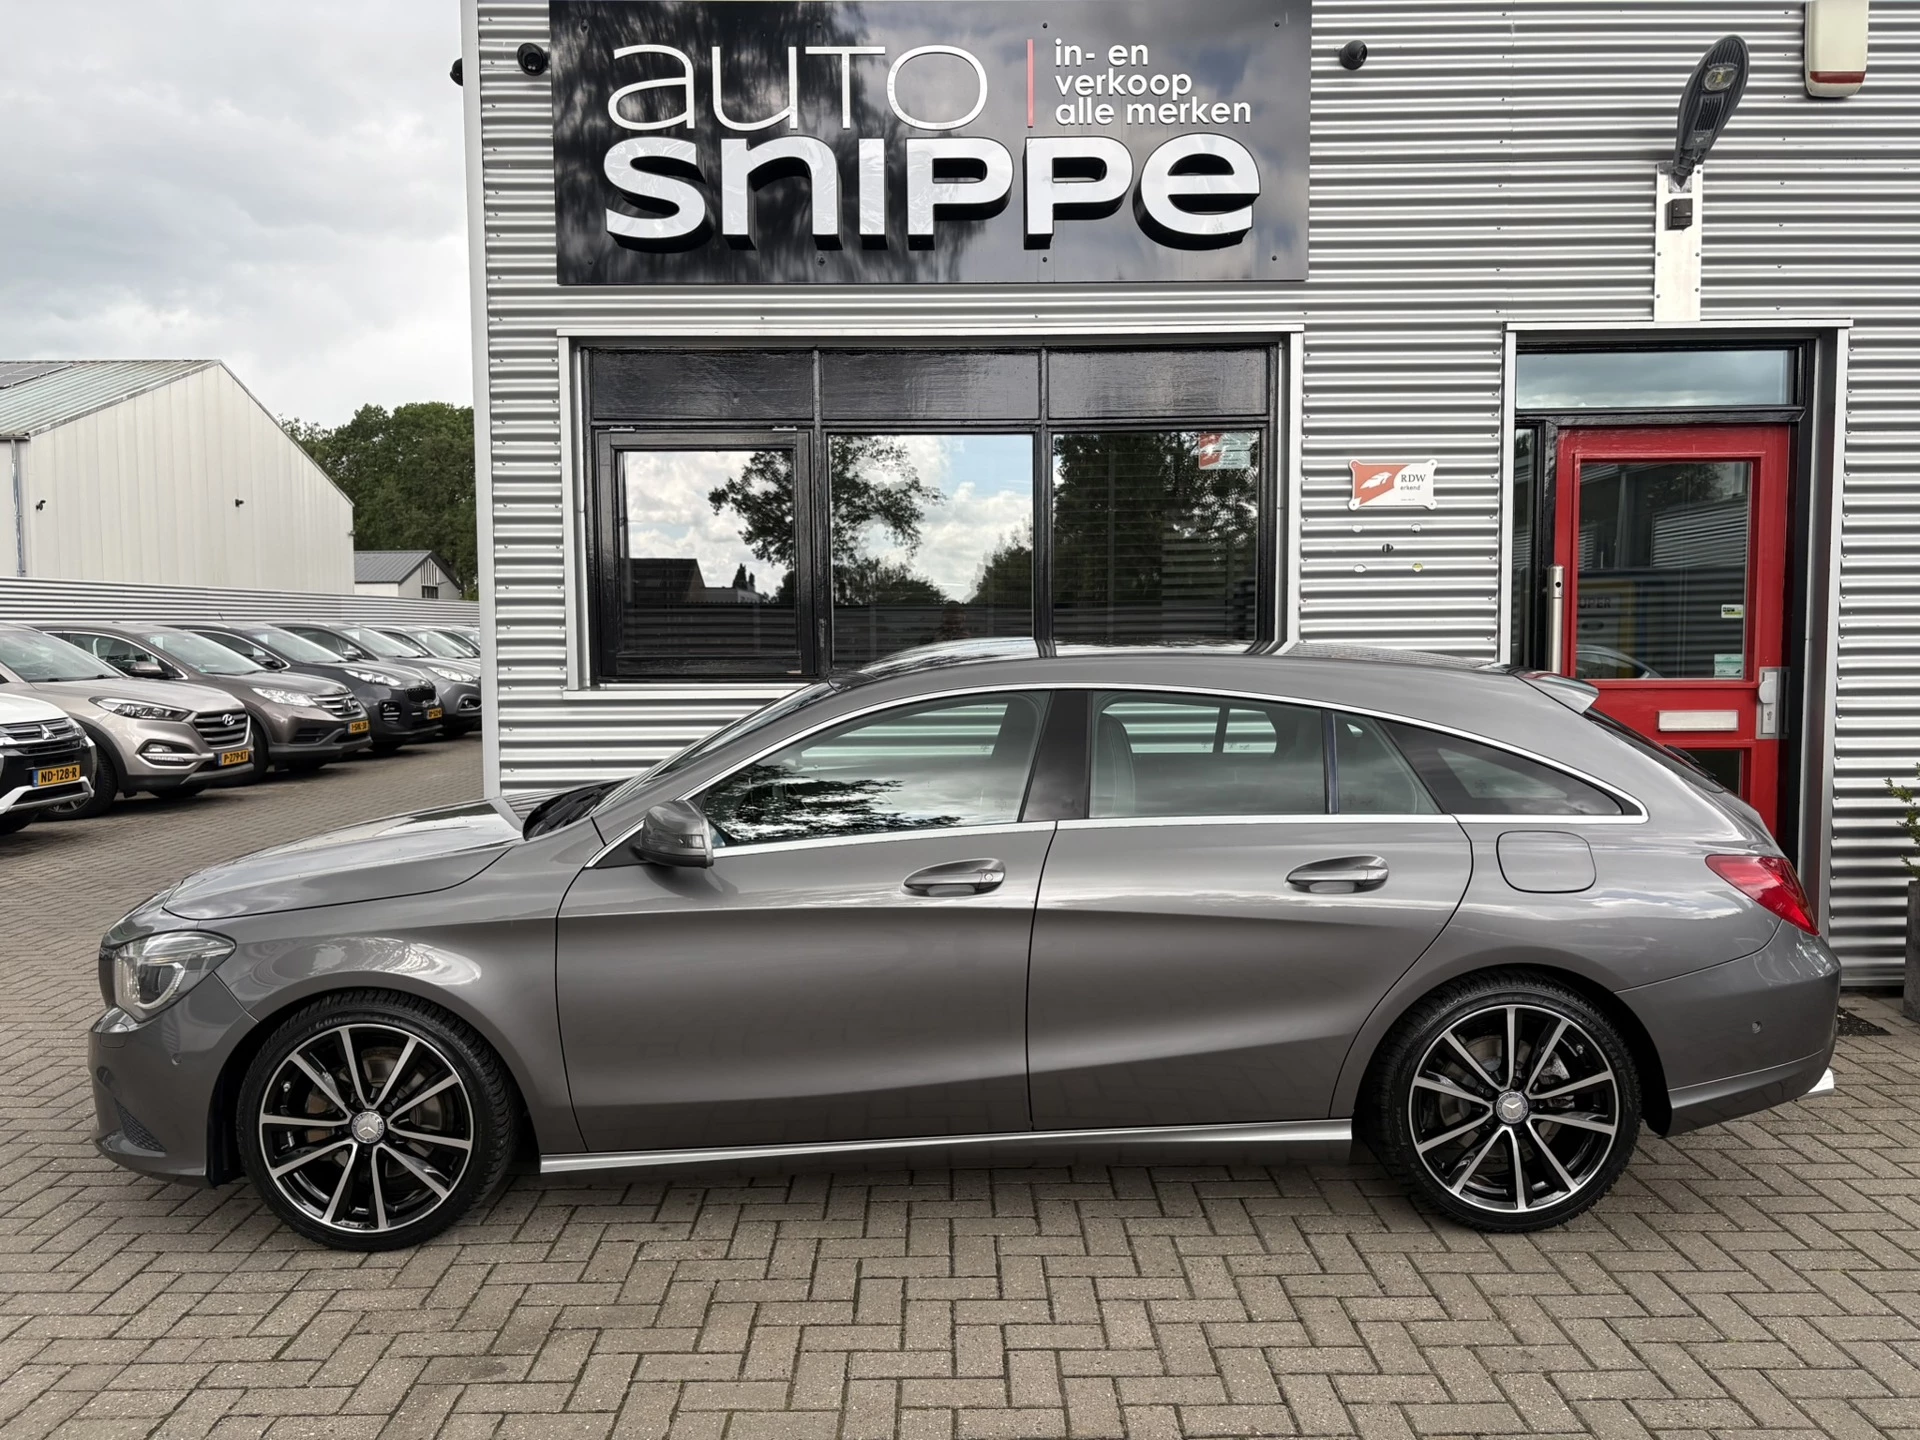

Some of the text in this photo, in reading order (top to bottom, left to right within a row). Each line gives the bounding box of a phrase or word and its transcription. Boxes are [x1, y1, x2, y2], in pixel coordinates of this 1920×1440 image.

[1055, 38, 1148, 67] in- en
[1055, 68, 1192, 101] verkoop
[1055, 96, 1250, 125] alle merken
[1401, 474, 1426, 483] RDW
[40, 766, 77, 783] ND-128-R
